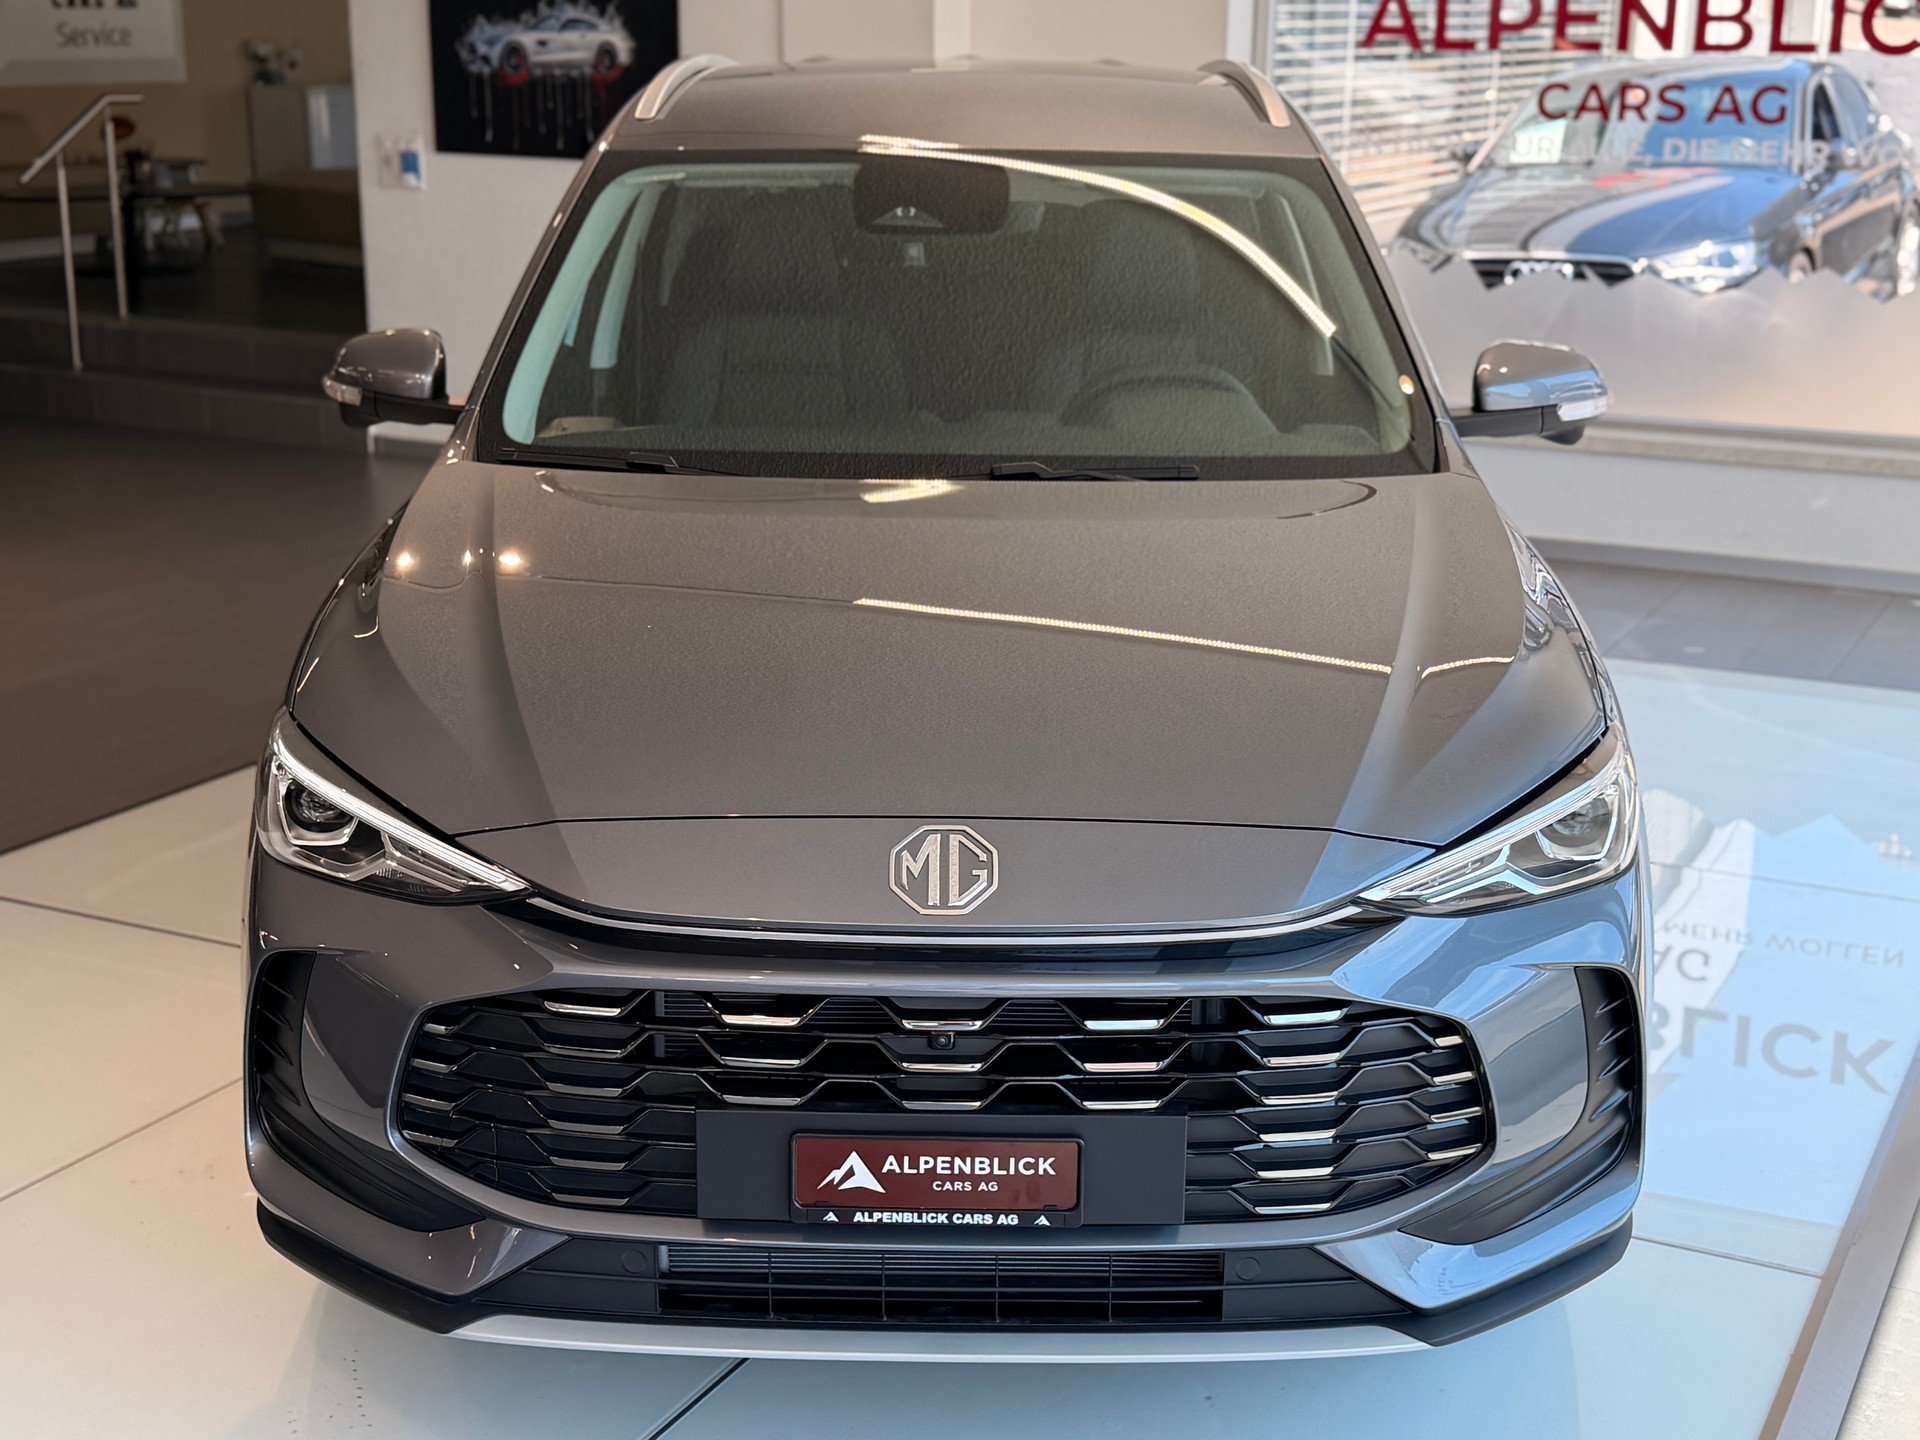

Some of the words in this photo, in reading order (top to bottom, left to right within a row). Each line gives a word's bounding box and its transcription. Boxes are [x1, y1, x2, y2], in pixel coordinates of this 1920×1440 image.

[55, 21, 132, 47] Service
[1537, 82, 1686, 123] CARS
[1705, 84, 1789, 125] AG
[1662, 137, 1719, 163] DIE
[900, 833, 988, 906] MG
[882, 1155, 1056, 1175] ALPENBLICK
[932, 1181, 972, 1192] CARS
[978, 1181, 998, 1192] AG
[853, 1211, 949, 1224] ALPENBLICK
[952, 1212, 993, 1225] CARS
[996, 1213, 1019, 1225] AG
